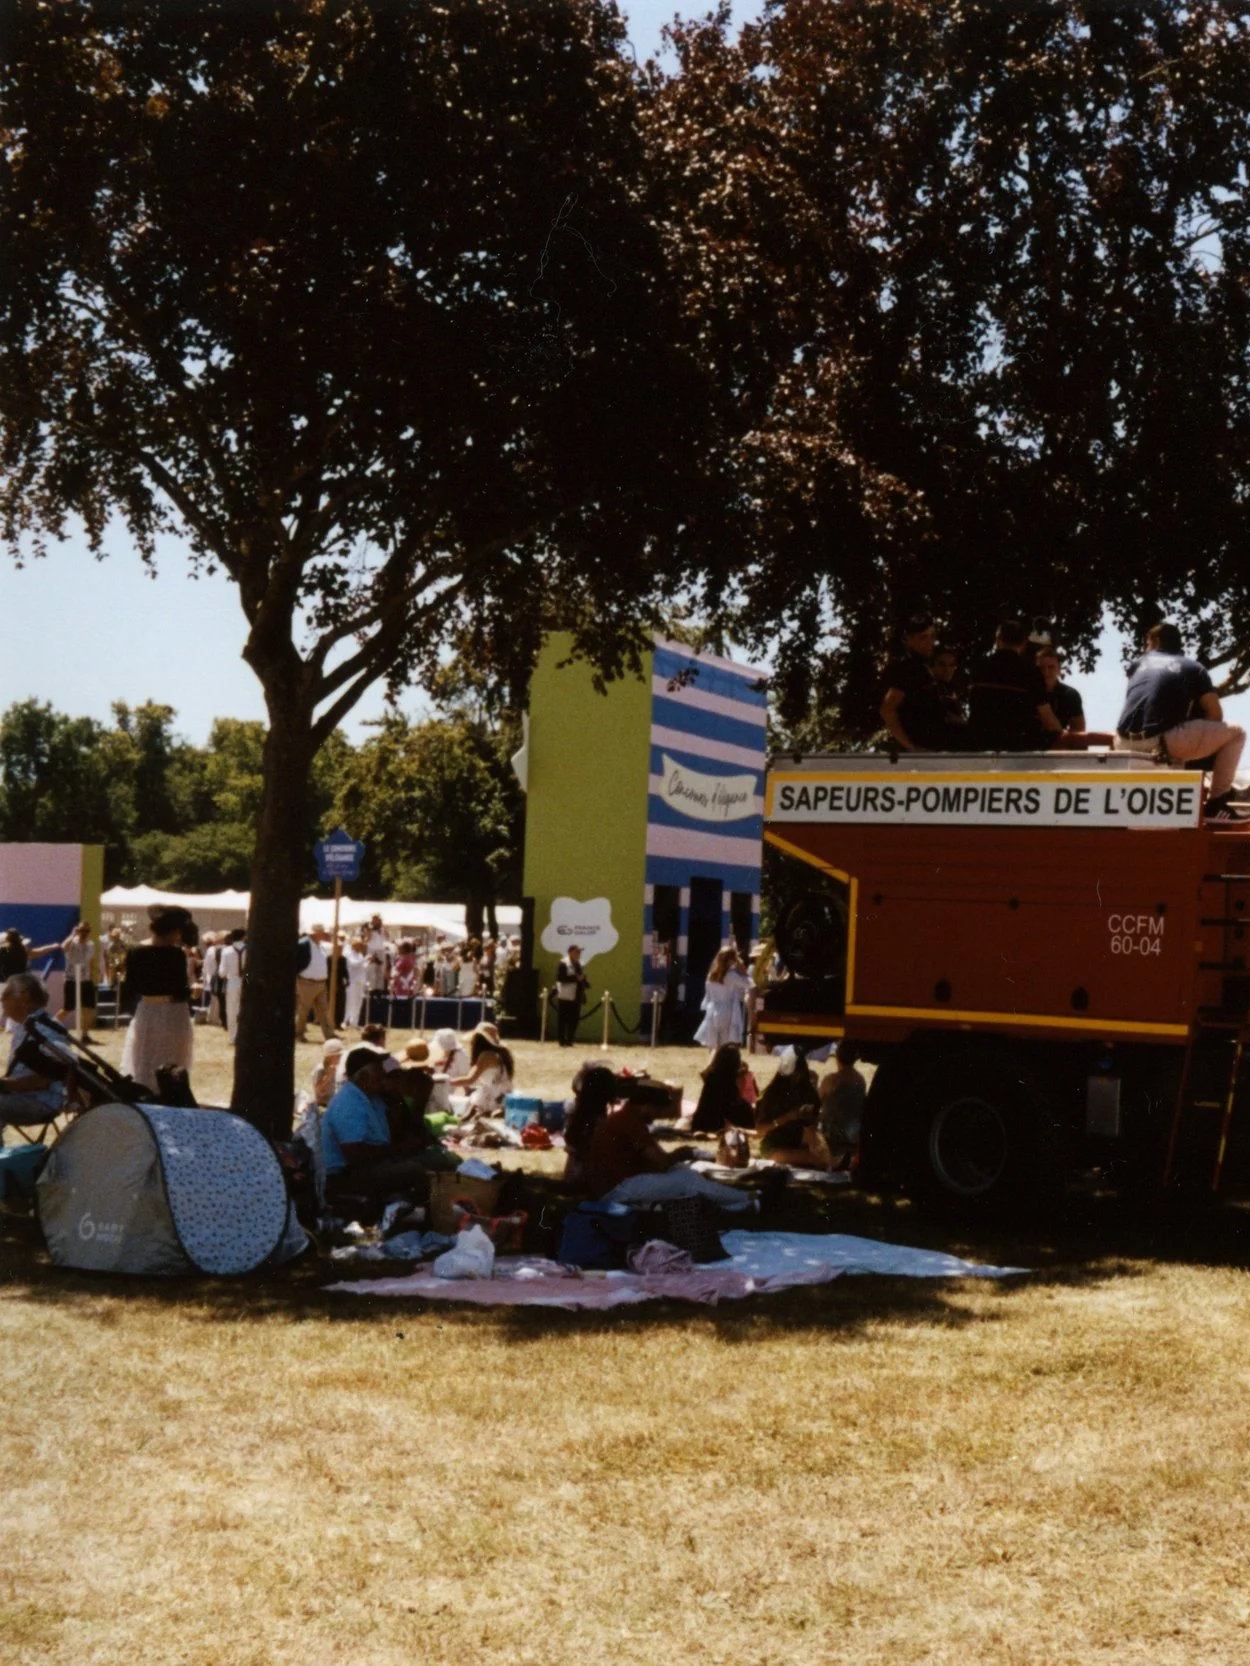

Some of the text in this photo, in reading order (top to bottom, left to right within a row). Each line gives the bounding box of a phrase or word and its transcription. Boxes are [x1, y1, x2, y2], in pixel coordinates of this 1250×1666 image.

[780, 786, 1194, 815] SAPEURS-POMPIERS DE L'OISE
[1108, 914, 1165, 935] CCFM
[1111, 935, 1161, 956] 60-04
